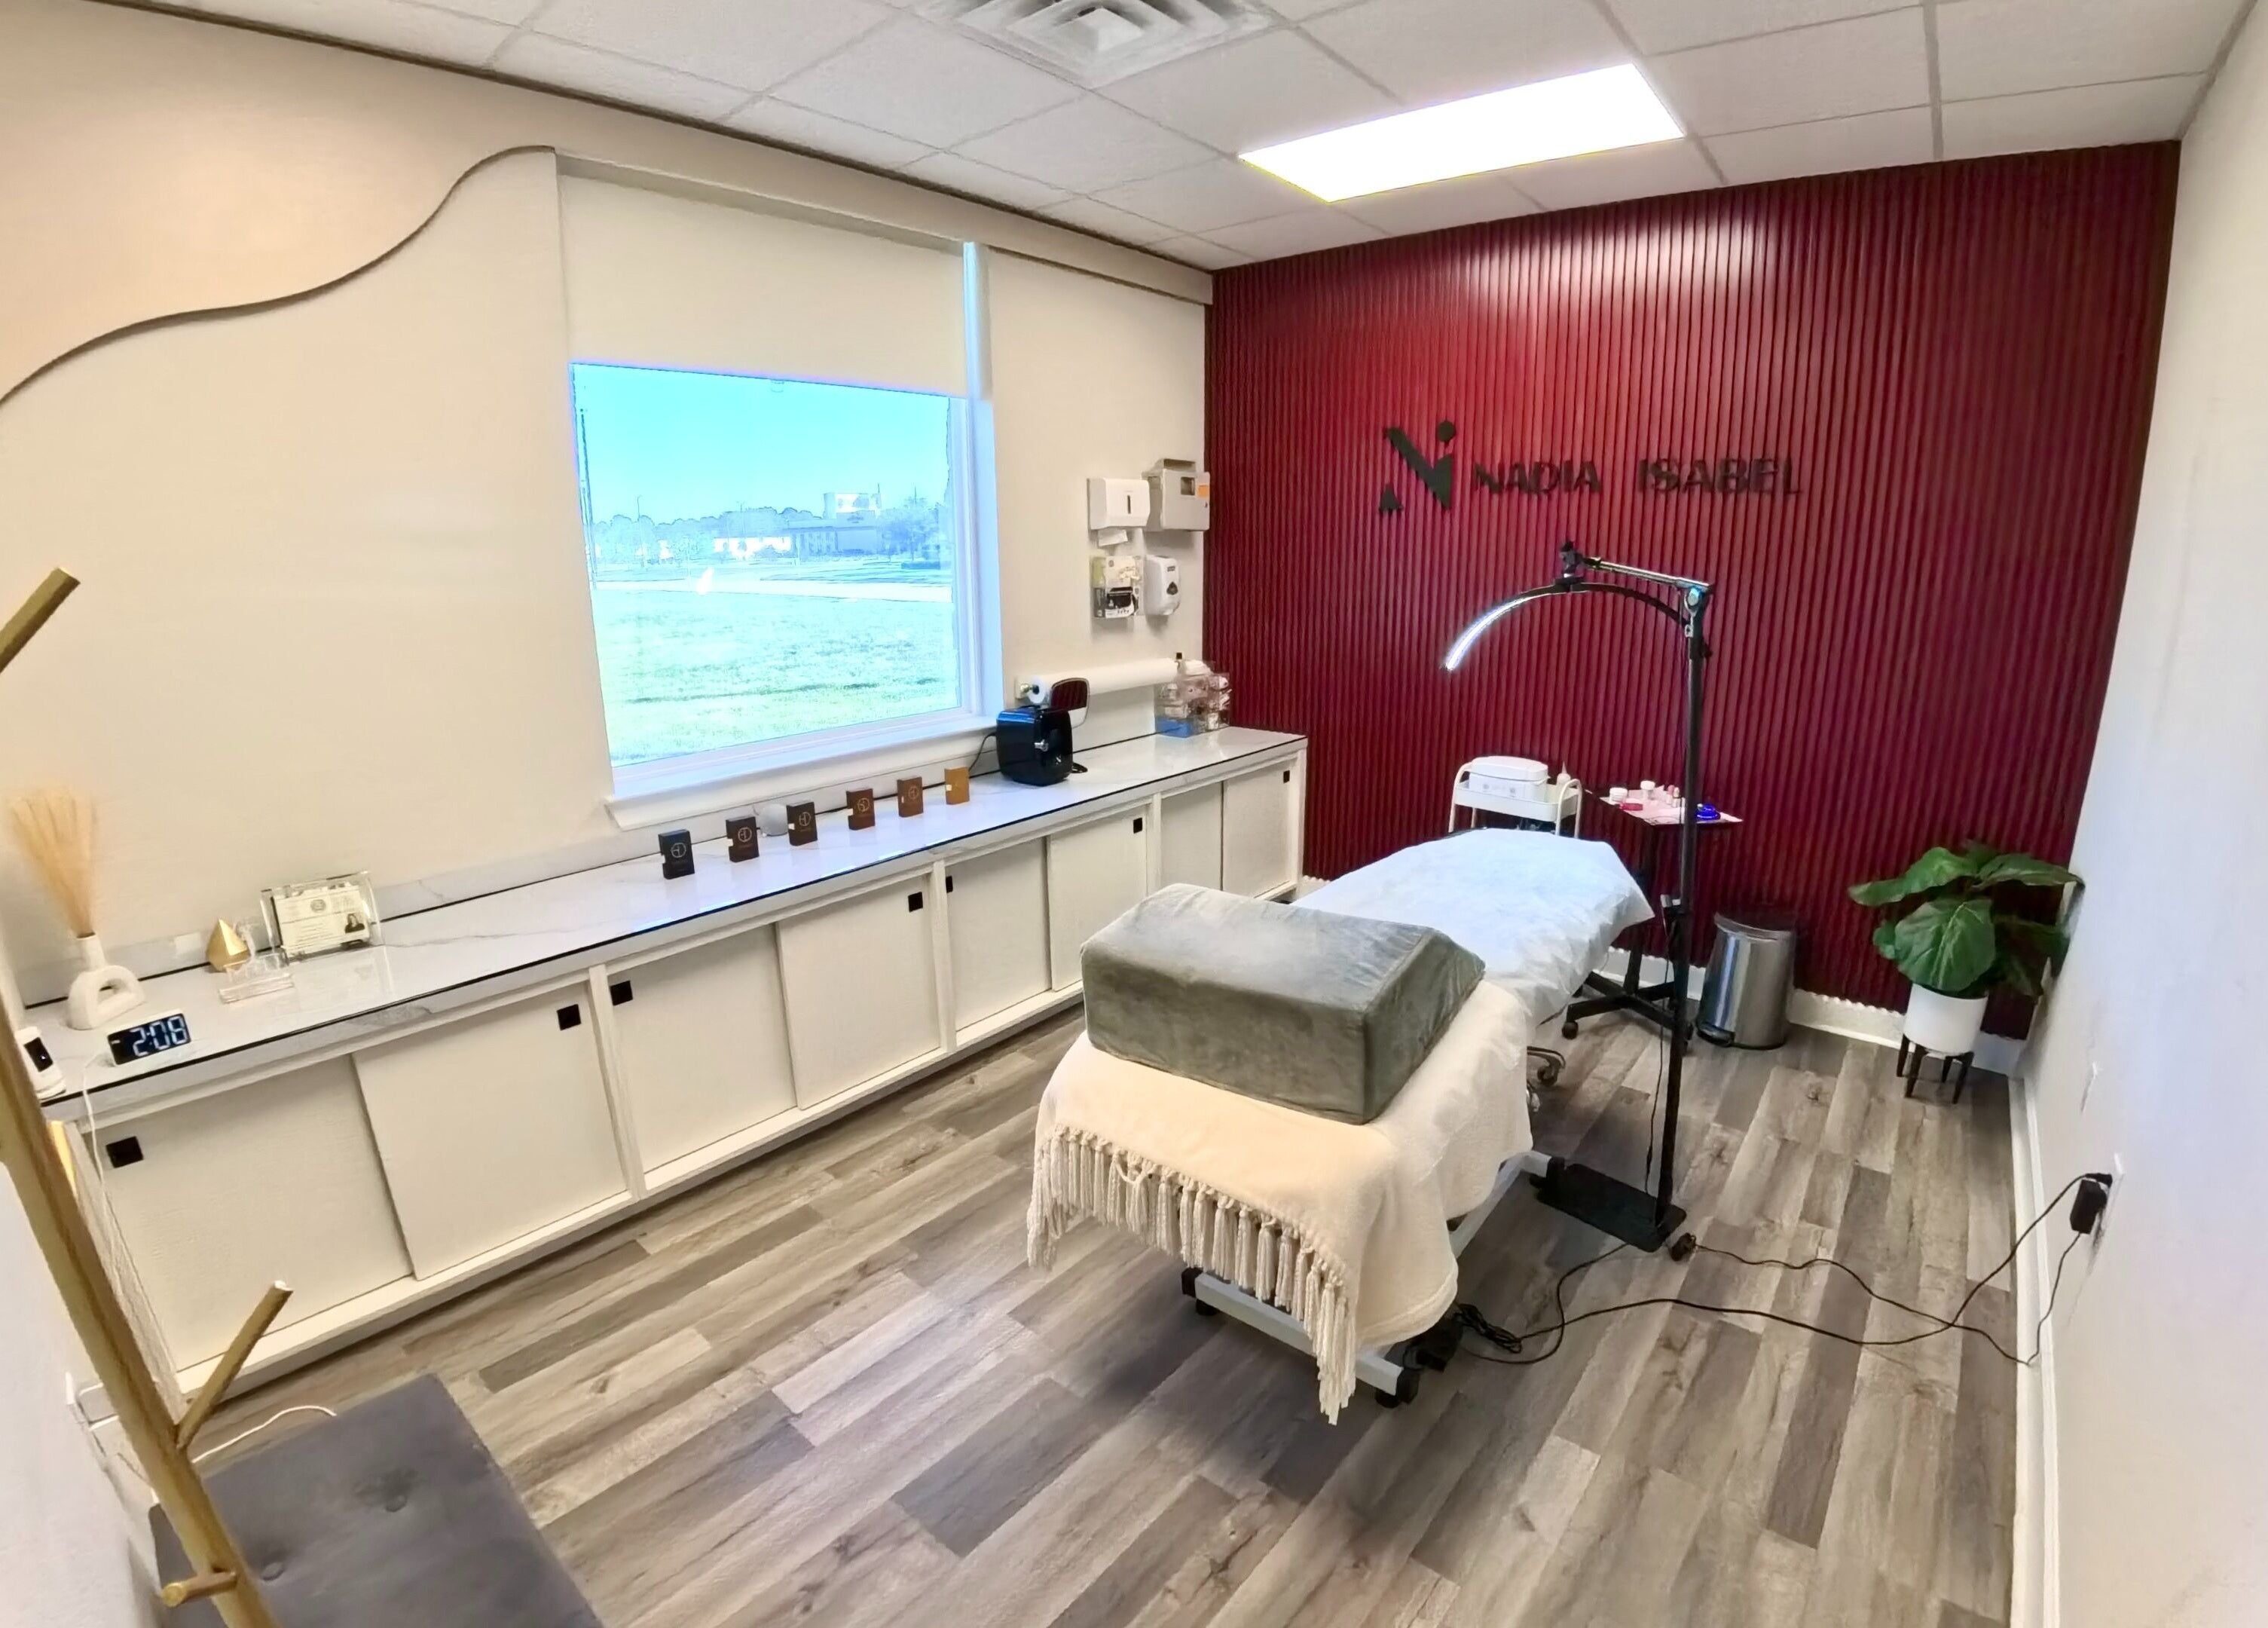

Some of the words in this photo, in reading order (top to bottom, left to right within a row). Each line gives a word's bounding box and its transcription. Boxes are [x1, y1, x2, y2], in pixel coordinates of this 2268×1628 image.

[1472, 459, 1603, 494] NADIA
[1637, 457, 1800, 494] ISABEL
[129, 1014, 189, 1057] 2:08
